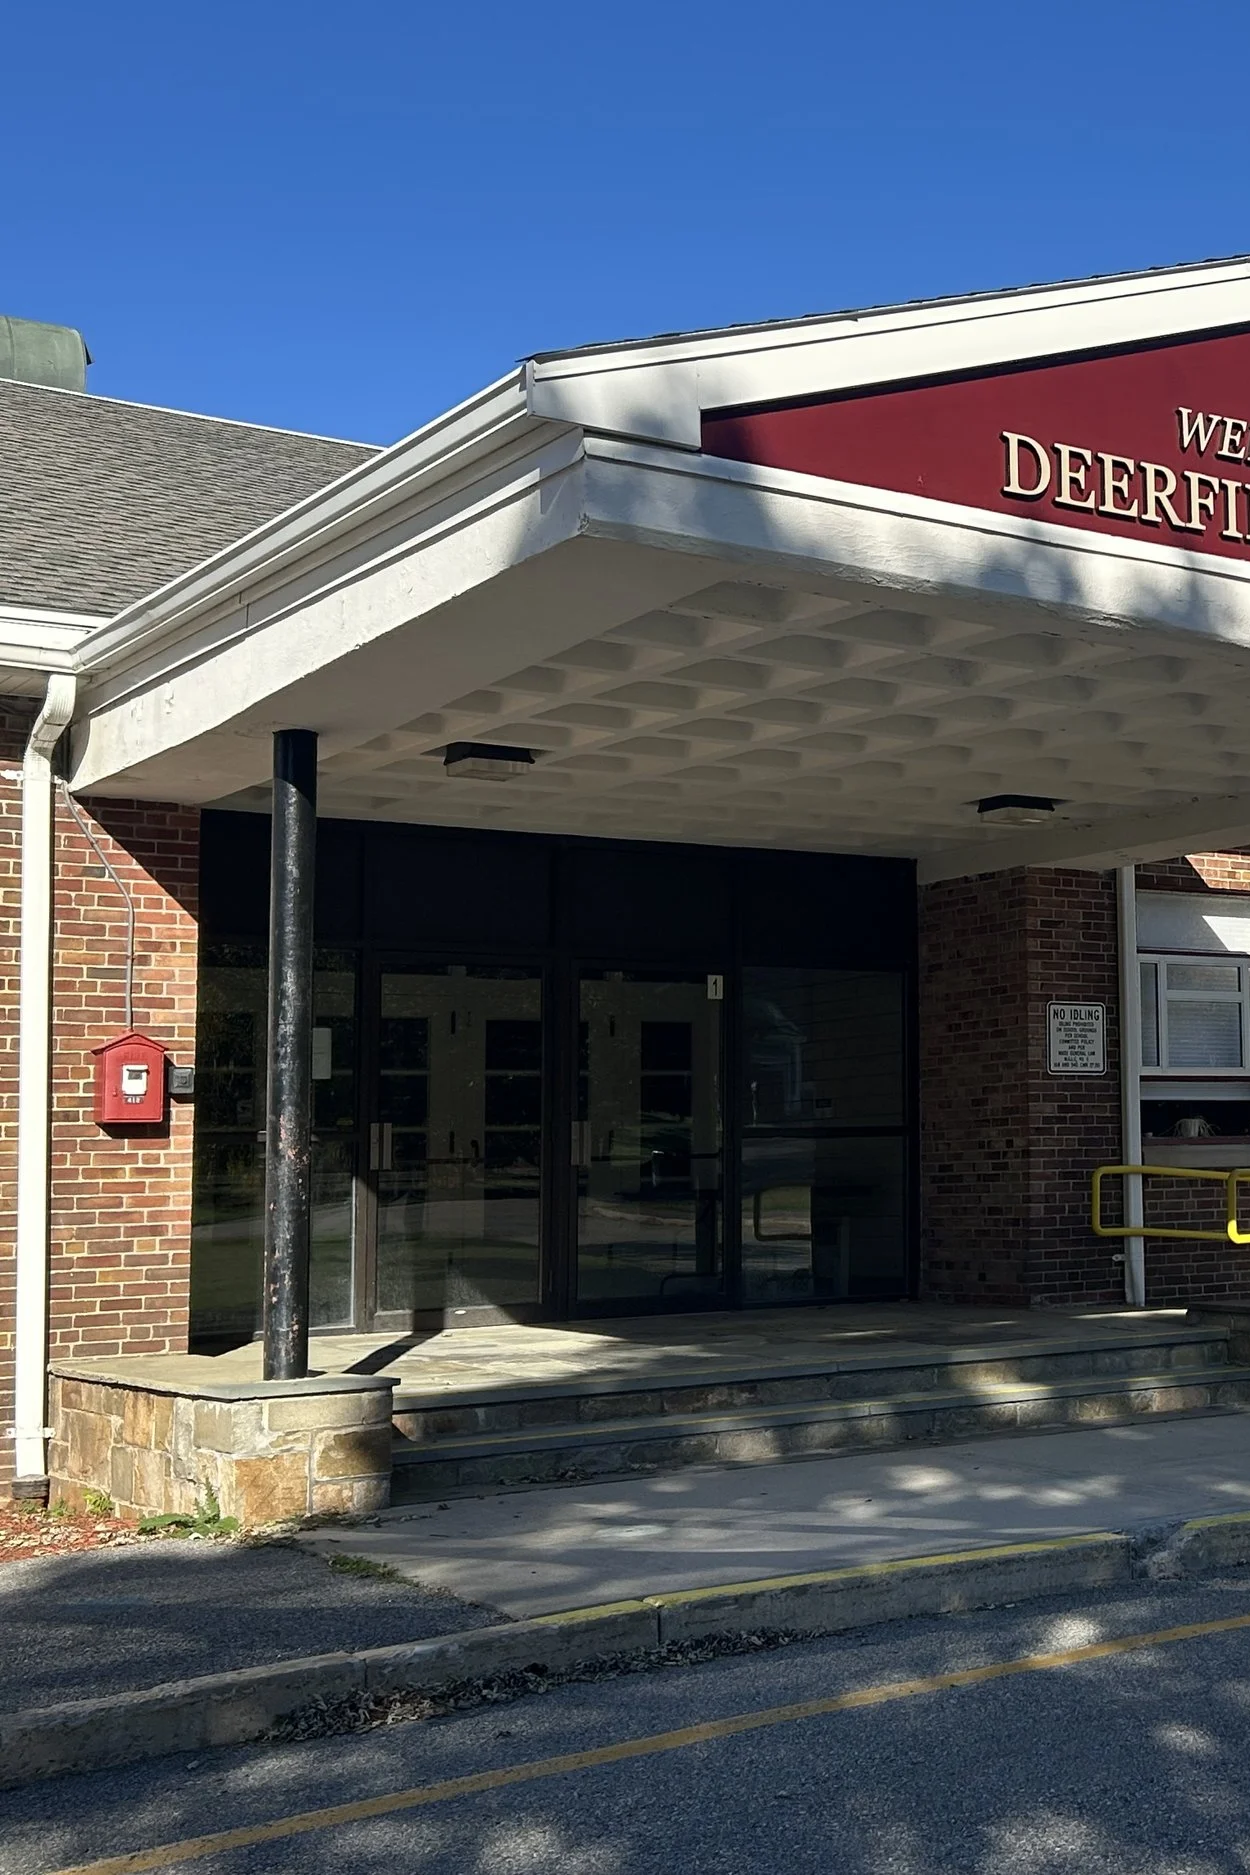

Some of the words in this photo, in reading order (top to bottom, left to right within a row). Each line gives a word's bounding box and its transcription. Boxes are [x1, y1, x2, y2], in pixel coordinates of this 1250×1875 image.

[712, 977, 718, 997] 1
[1053, 1009, 1066, 1020] NO
[1070, 1009, 1100, 1021] IDLING
